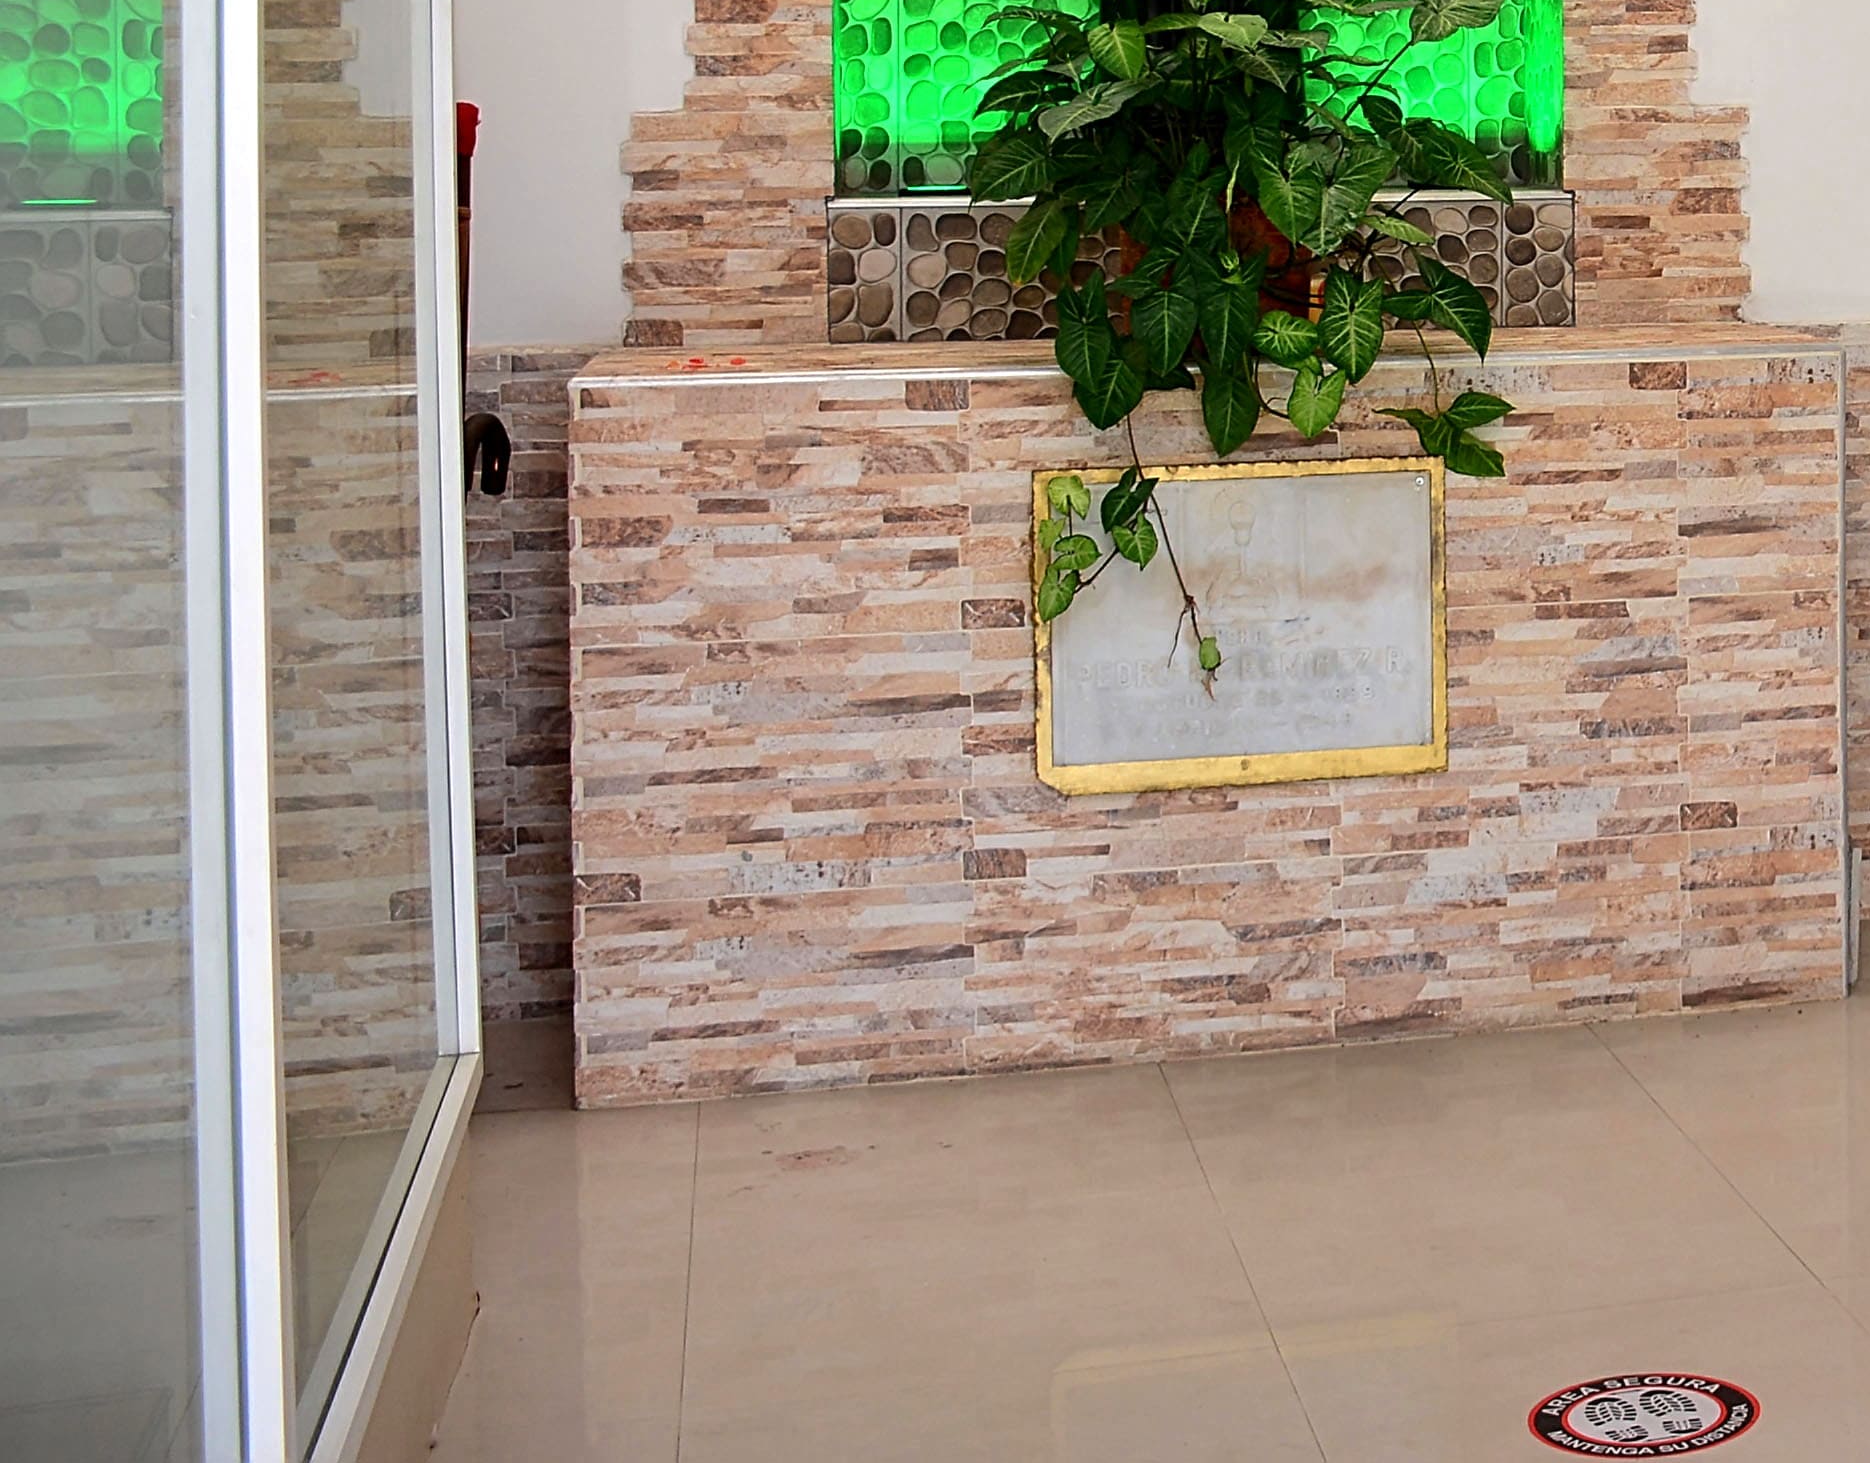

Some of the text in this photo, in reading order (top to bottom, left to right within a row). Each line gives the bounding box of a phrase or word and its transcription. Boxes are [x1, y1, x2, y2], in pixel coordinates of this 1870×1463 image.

[1542, 1376, 1720, 1416] AREA SEGURA
[1547, 1403, 1748, 1455] MANTENGA SU DISTANCIA
